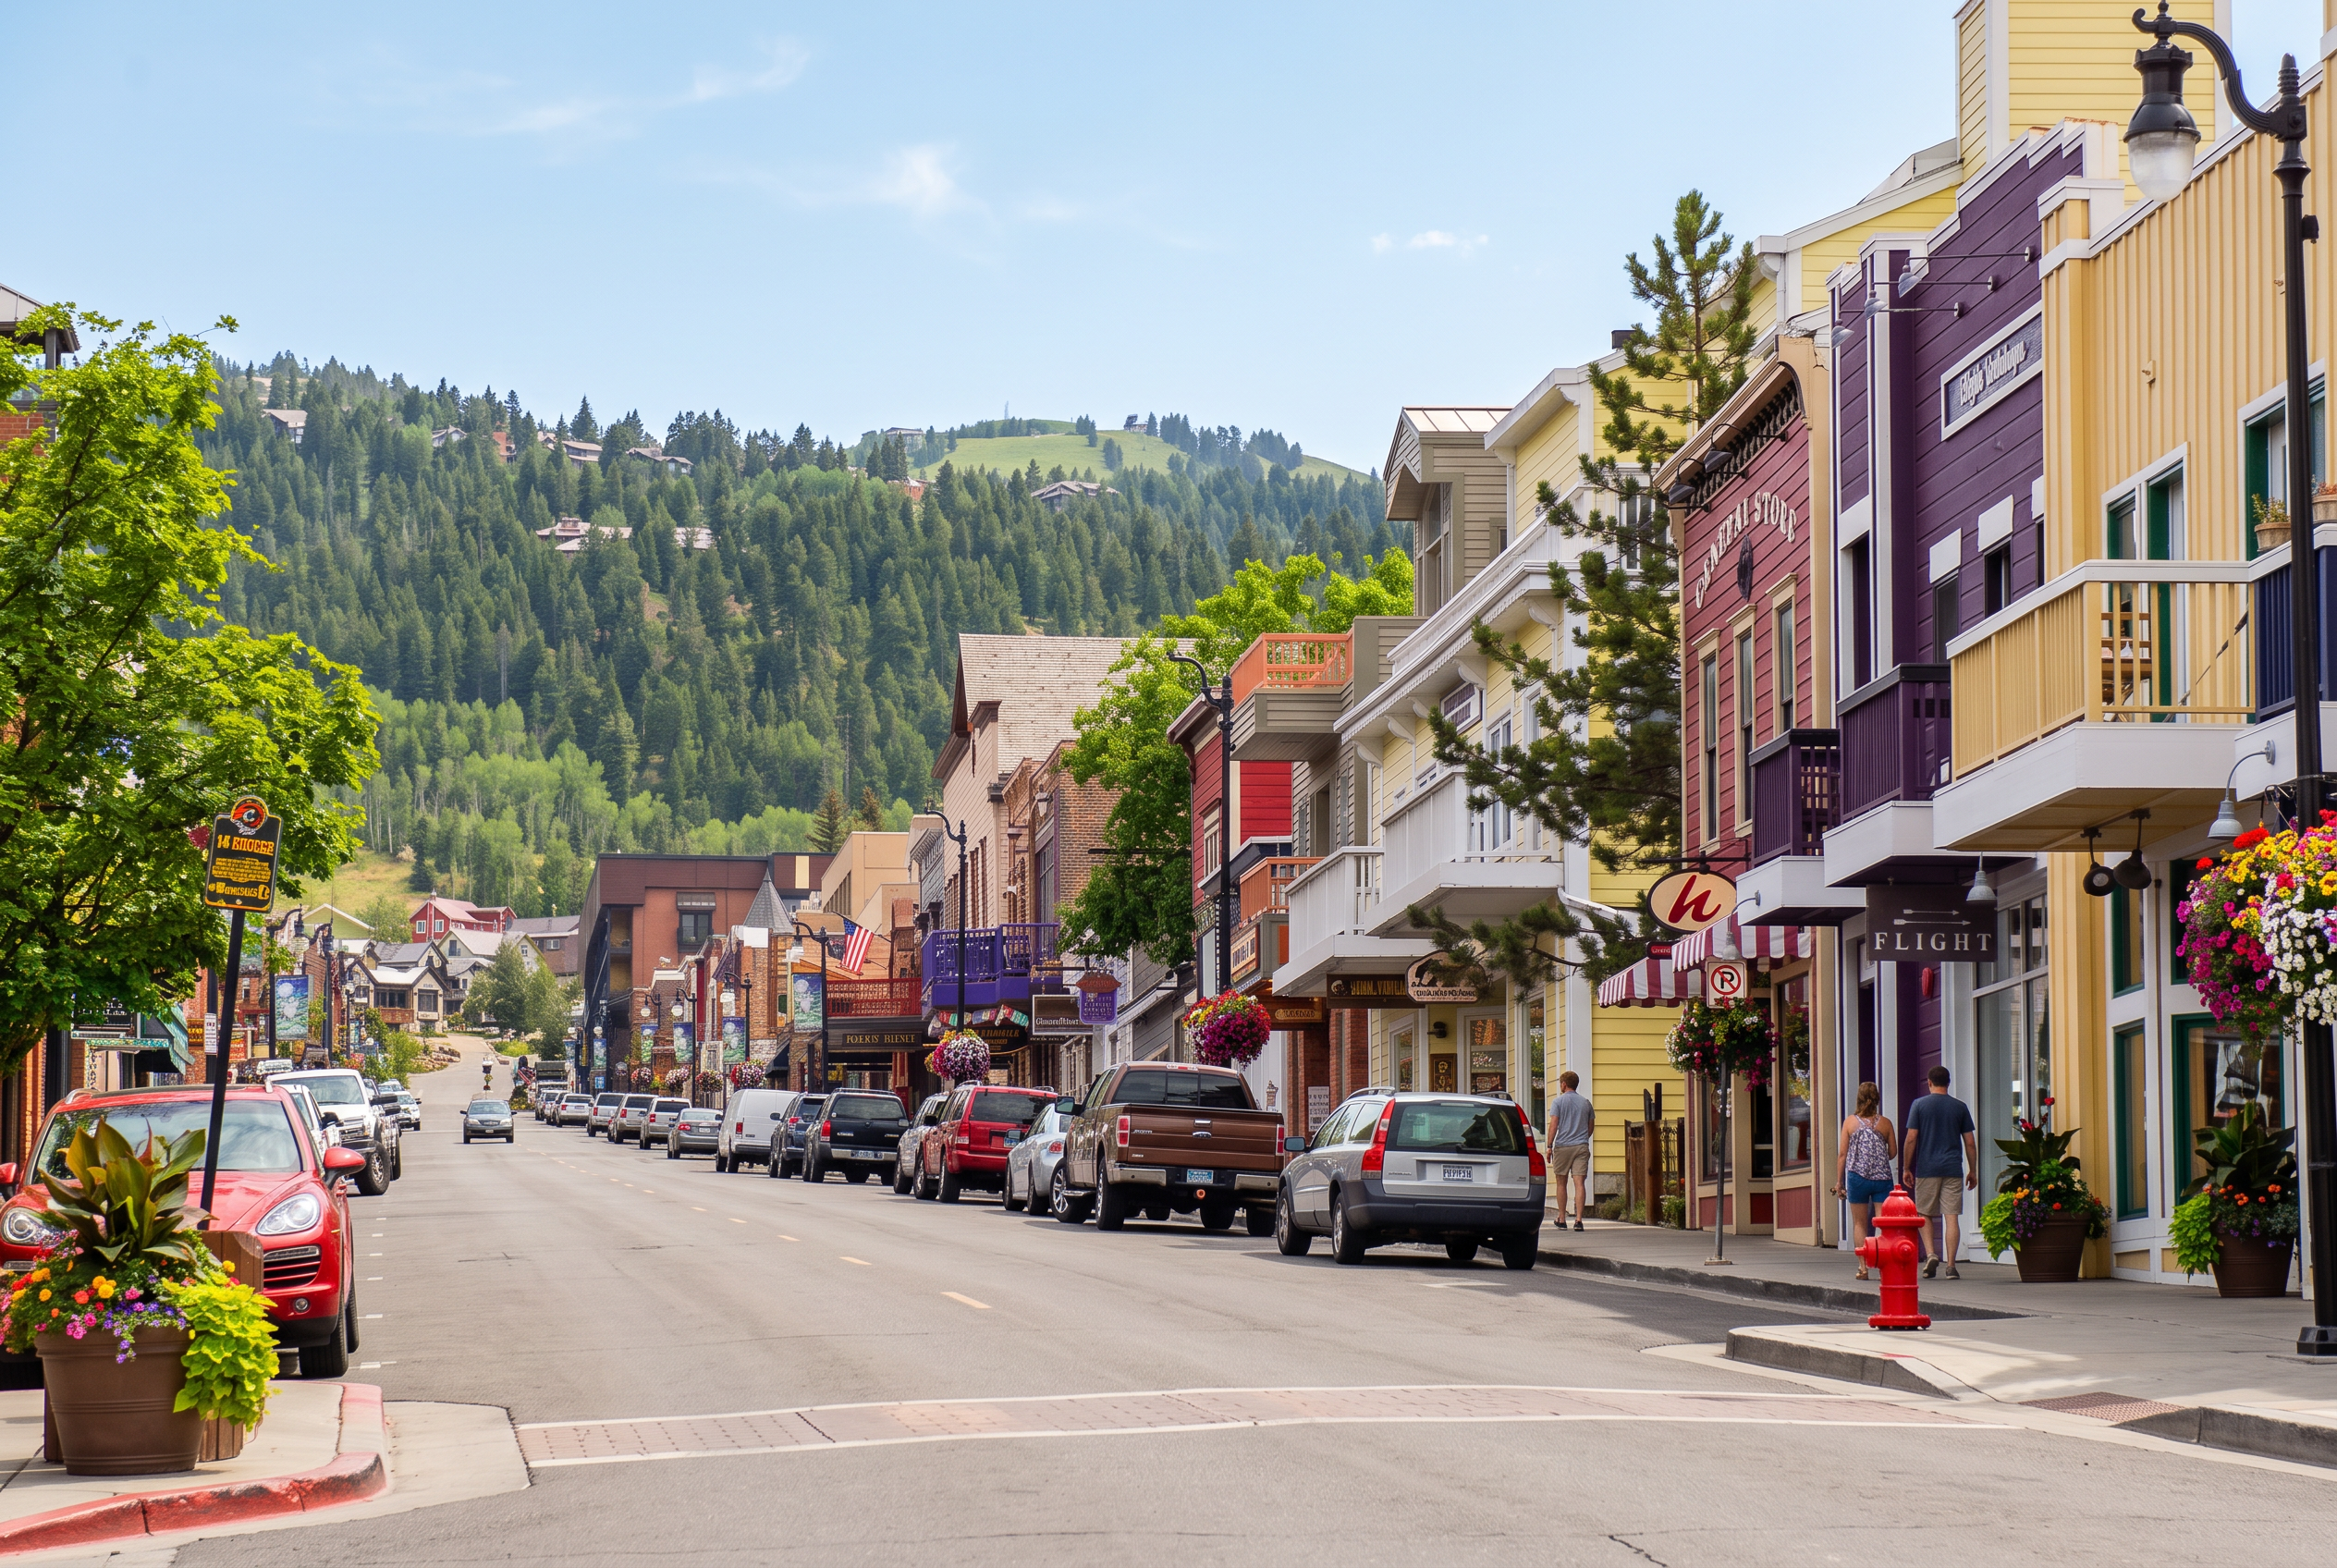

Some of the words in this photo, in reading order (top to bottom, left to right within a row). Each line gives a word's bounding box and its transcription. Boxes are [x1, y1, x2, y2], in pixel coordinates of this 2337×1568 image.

[1668, 874, 1722, 924] h
[1874, 931, 1992, 951] FLIGHT
[1720, 971, 1734, 989] P
